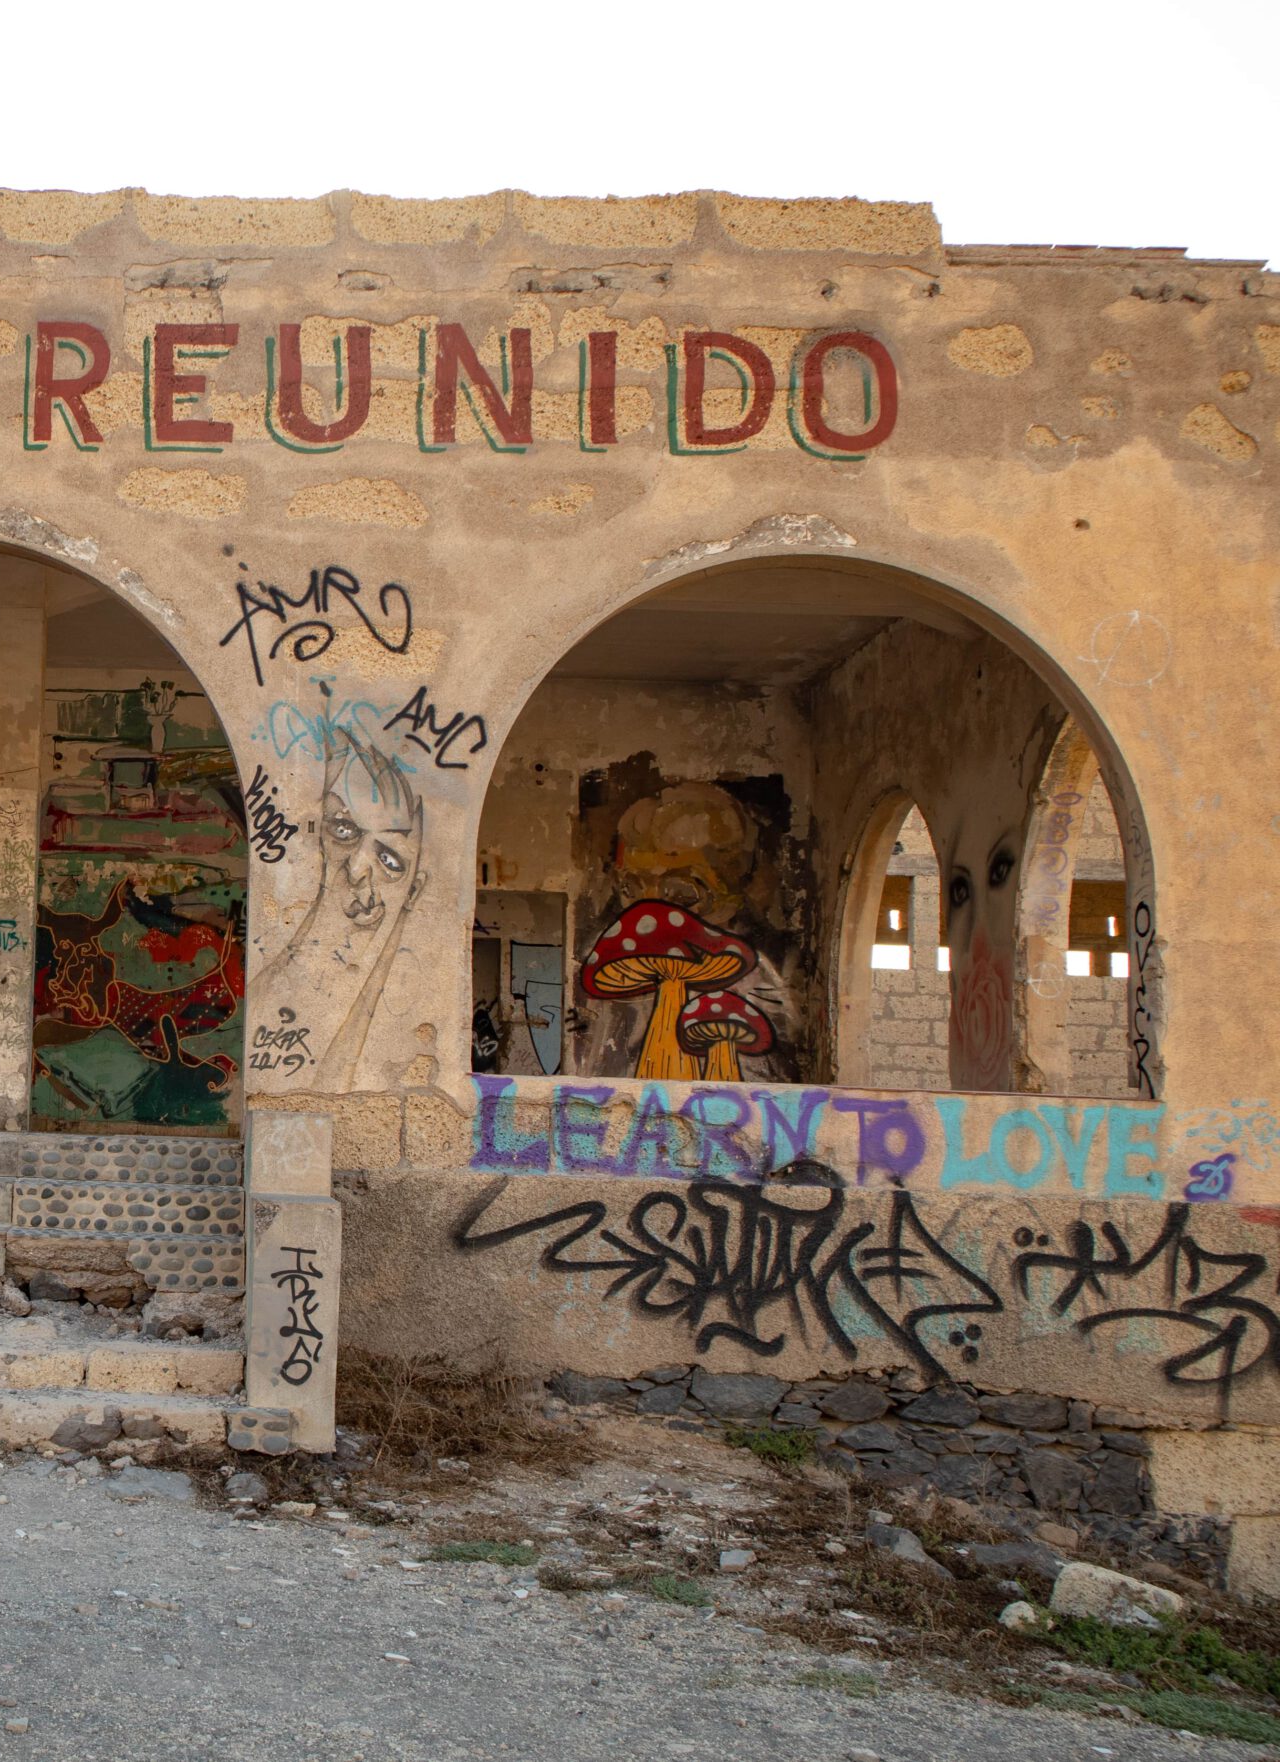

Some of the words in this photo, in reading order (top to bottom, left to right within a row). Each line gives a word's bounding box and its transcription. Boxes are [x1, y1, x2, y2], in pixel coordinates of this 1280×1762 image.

[23, 320, 900, 461] REUNIDO
[470, 1072, 830, 1180] LEARN
[831, 1096, 926, 1186] TO
[934, 1096, 1167, 1201] LOVE
